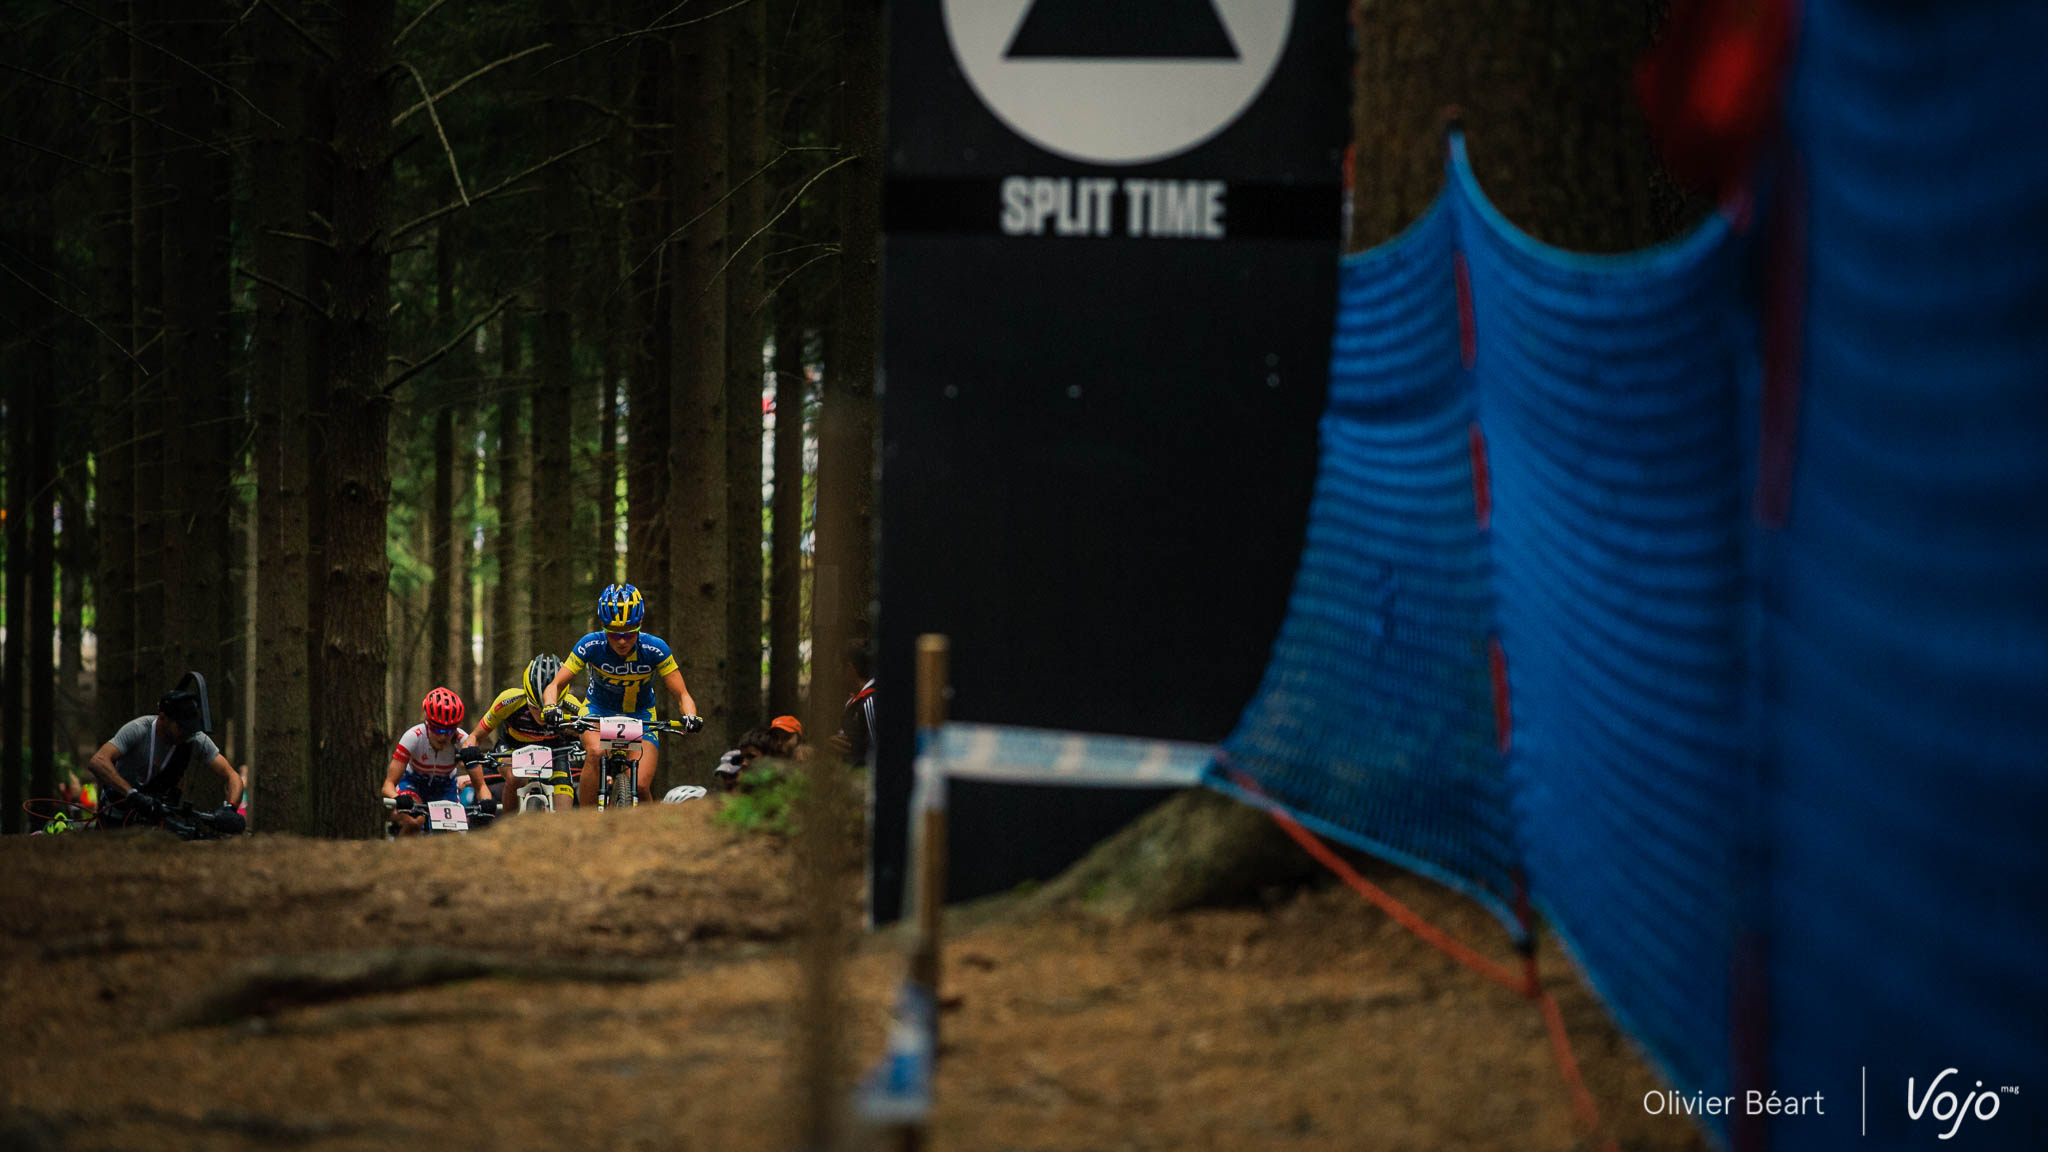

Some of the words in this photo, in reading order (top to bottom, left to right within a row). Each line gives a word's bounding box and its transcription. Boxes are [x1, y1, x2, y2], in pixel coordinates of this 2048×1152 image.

[1001, 176, 1117, 236] SPLIT
[1123, 178, 1226, 239] TIME
[601, 662, 652, 675] odlo
[616, 723, 626, 739] 2
[528, 752, 535, 766] 1
[443, 807, 453, 820] 8
